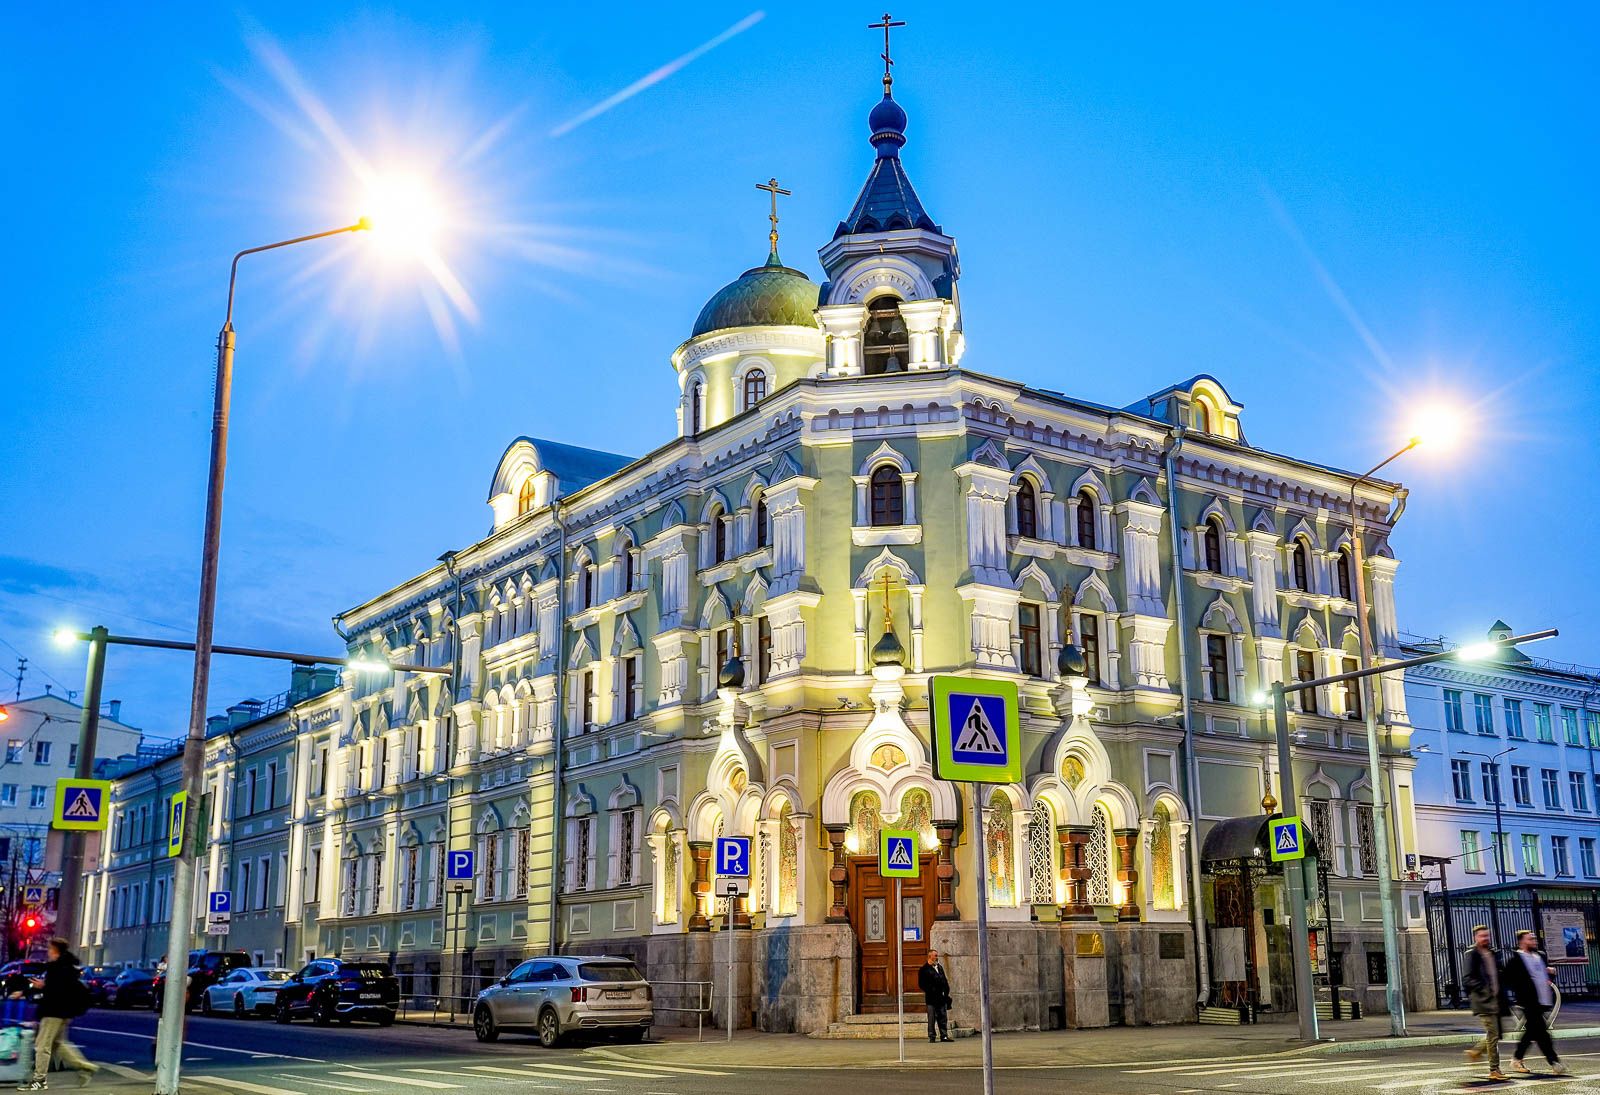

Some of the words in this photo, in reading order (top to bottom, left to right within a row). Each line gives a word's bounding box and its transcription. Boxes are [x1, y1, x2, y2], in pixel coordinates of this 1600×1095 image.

[454, 853, 469, 876] P
[723, 841, 742, 870] P
[215, 893, 227, 910] P
